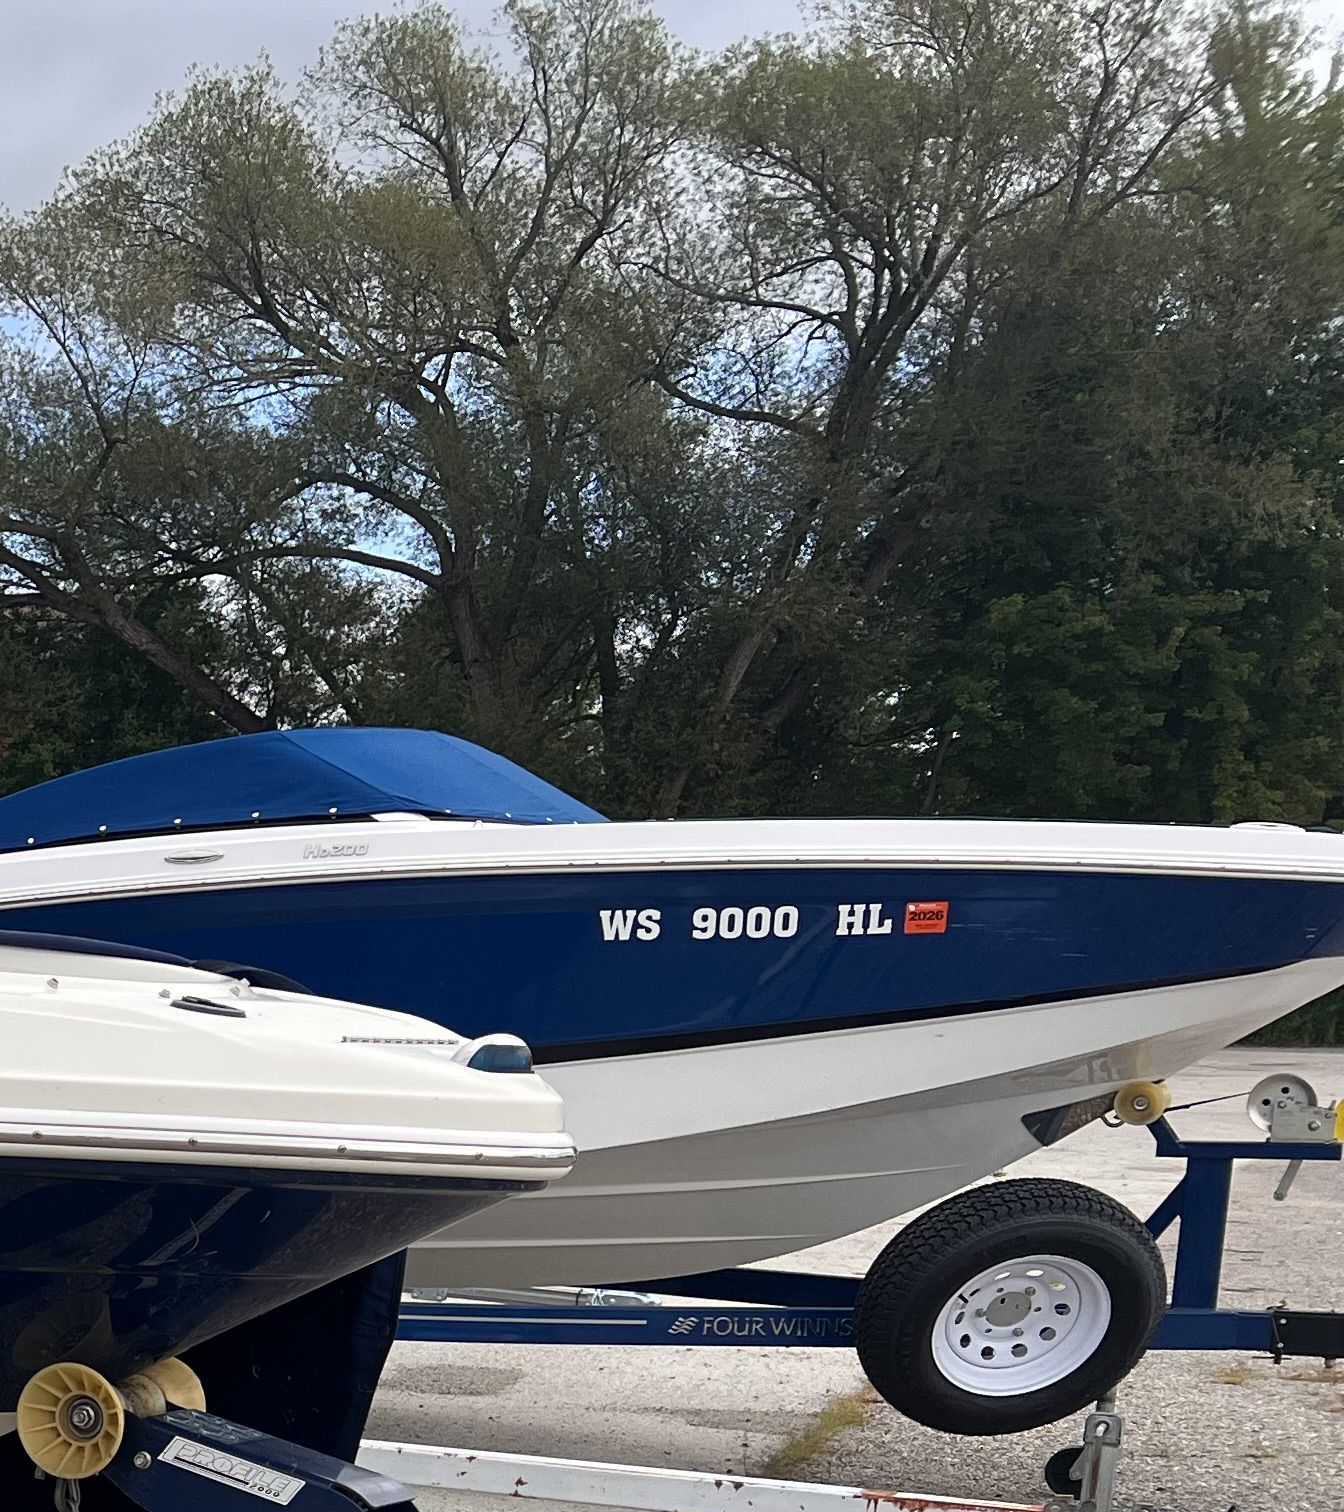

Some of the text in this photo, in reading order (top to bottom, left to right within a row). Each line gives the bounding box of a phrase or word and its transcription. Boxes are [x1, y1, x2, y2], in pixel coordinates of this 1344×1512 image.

[599, 903, 893, 941] WS 9000 HL
[908, 910, 944, 921] 2026
[702, 1316, 854, 1337] FOUR WINNS
[176, 1443, 291, 1493] PROFILE
[249, 1482, 280, 1498] 2000
